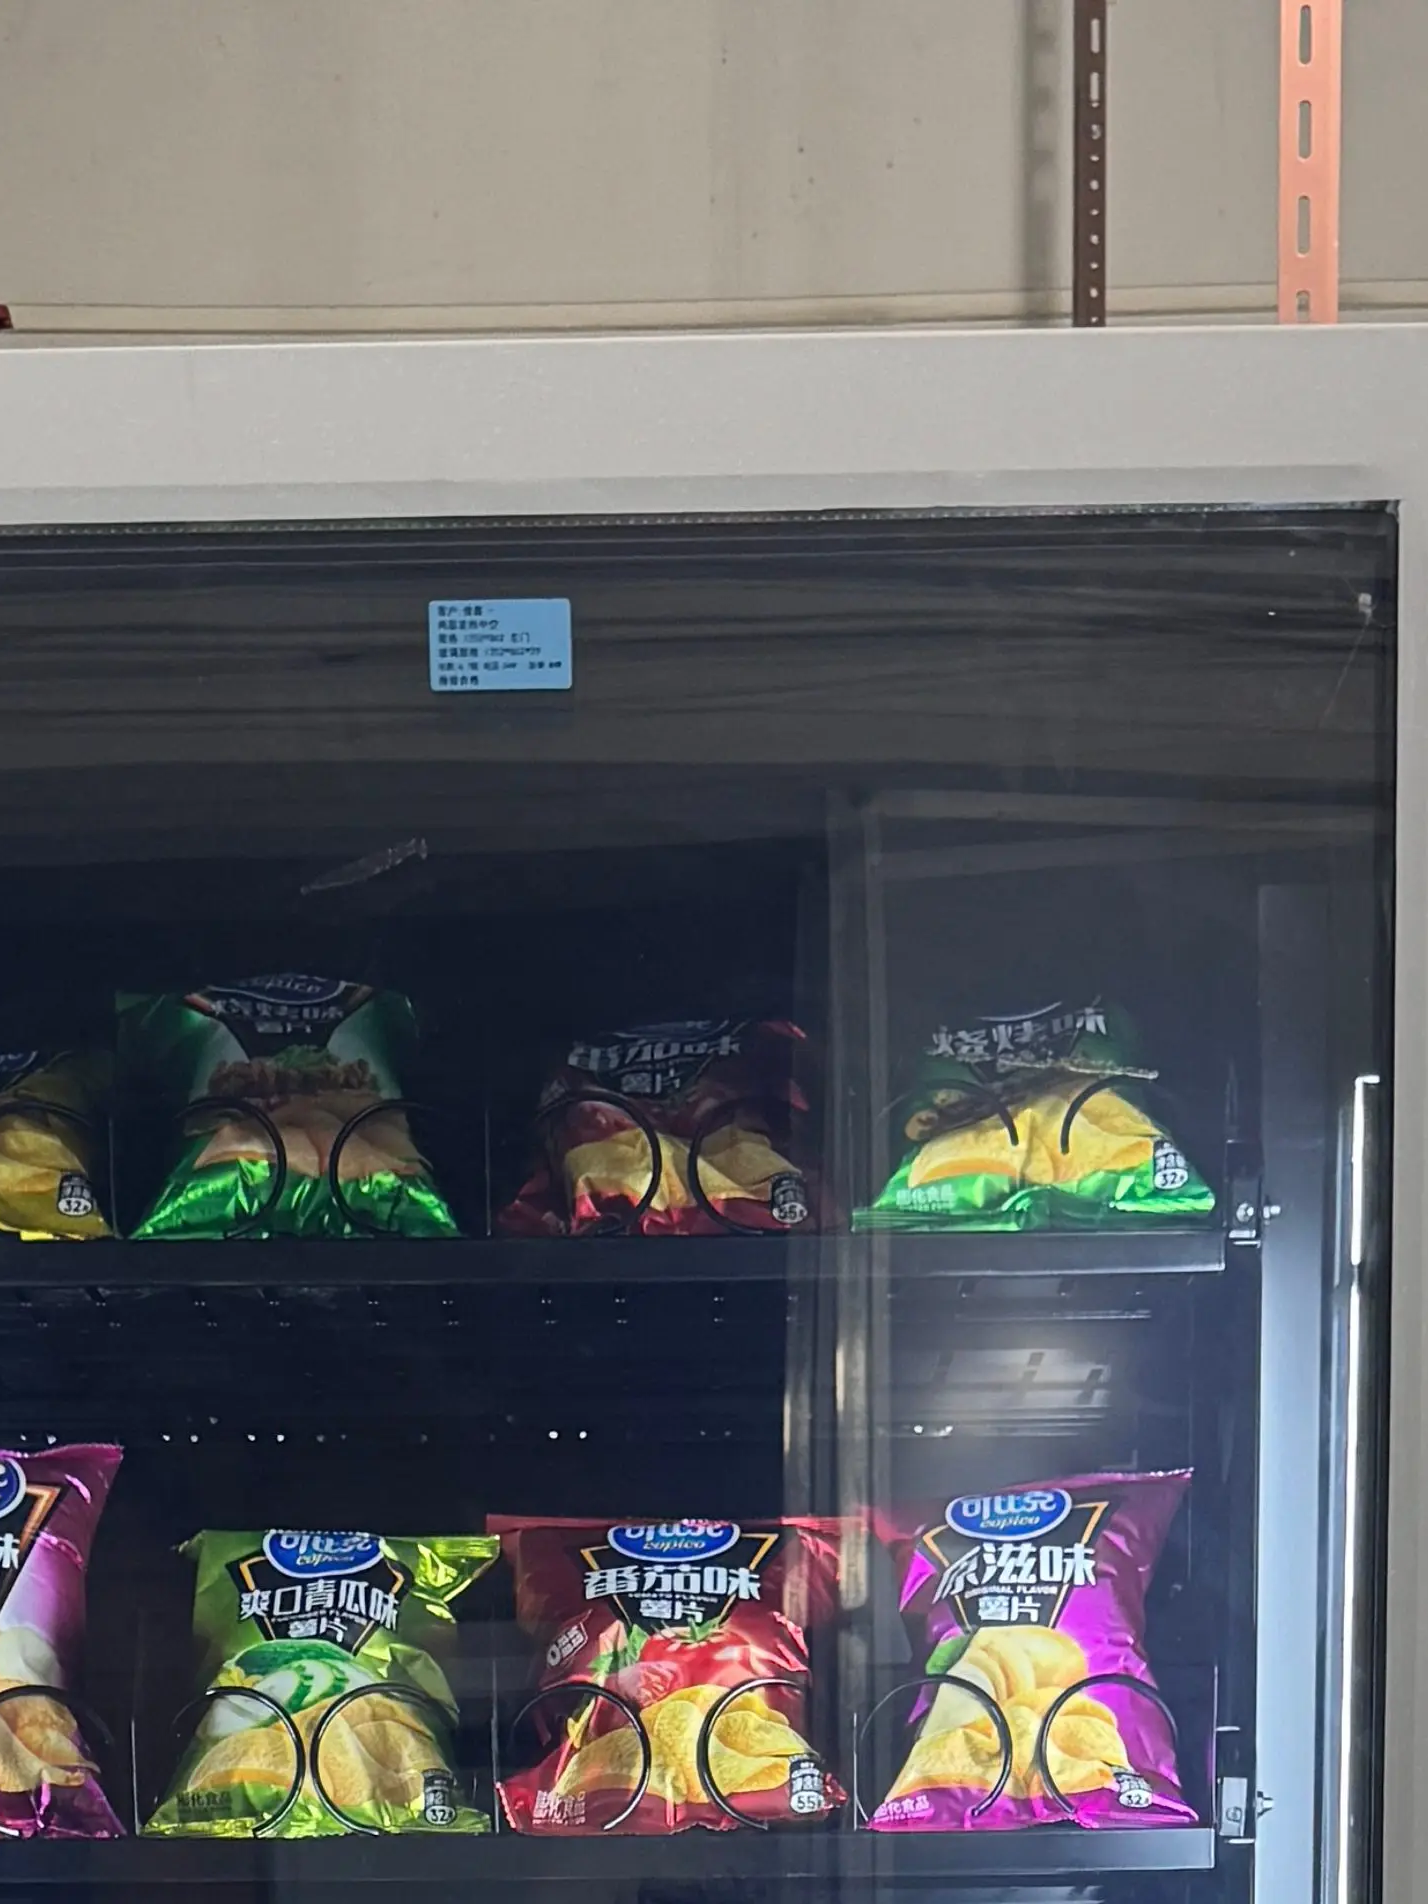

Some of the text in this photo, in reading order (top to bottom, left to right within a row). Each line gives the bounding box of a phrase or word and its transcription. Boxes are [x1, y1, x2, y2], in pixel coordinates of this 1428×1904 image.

[980, 1513, 1040, 1529] copico
[584, 1564, 760, 1601] 番茄味
[932, 1542, 1097, 1604] 原滋味
[240, 1578, 400, 1632] 爽口青瓜味
[639, 1600, 706, 1622] 薯片
[978, 1597, 1041, 1622] 薯片
[288, 1617, 349, 1642] 薯片
